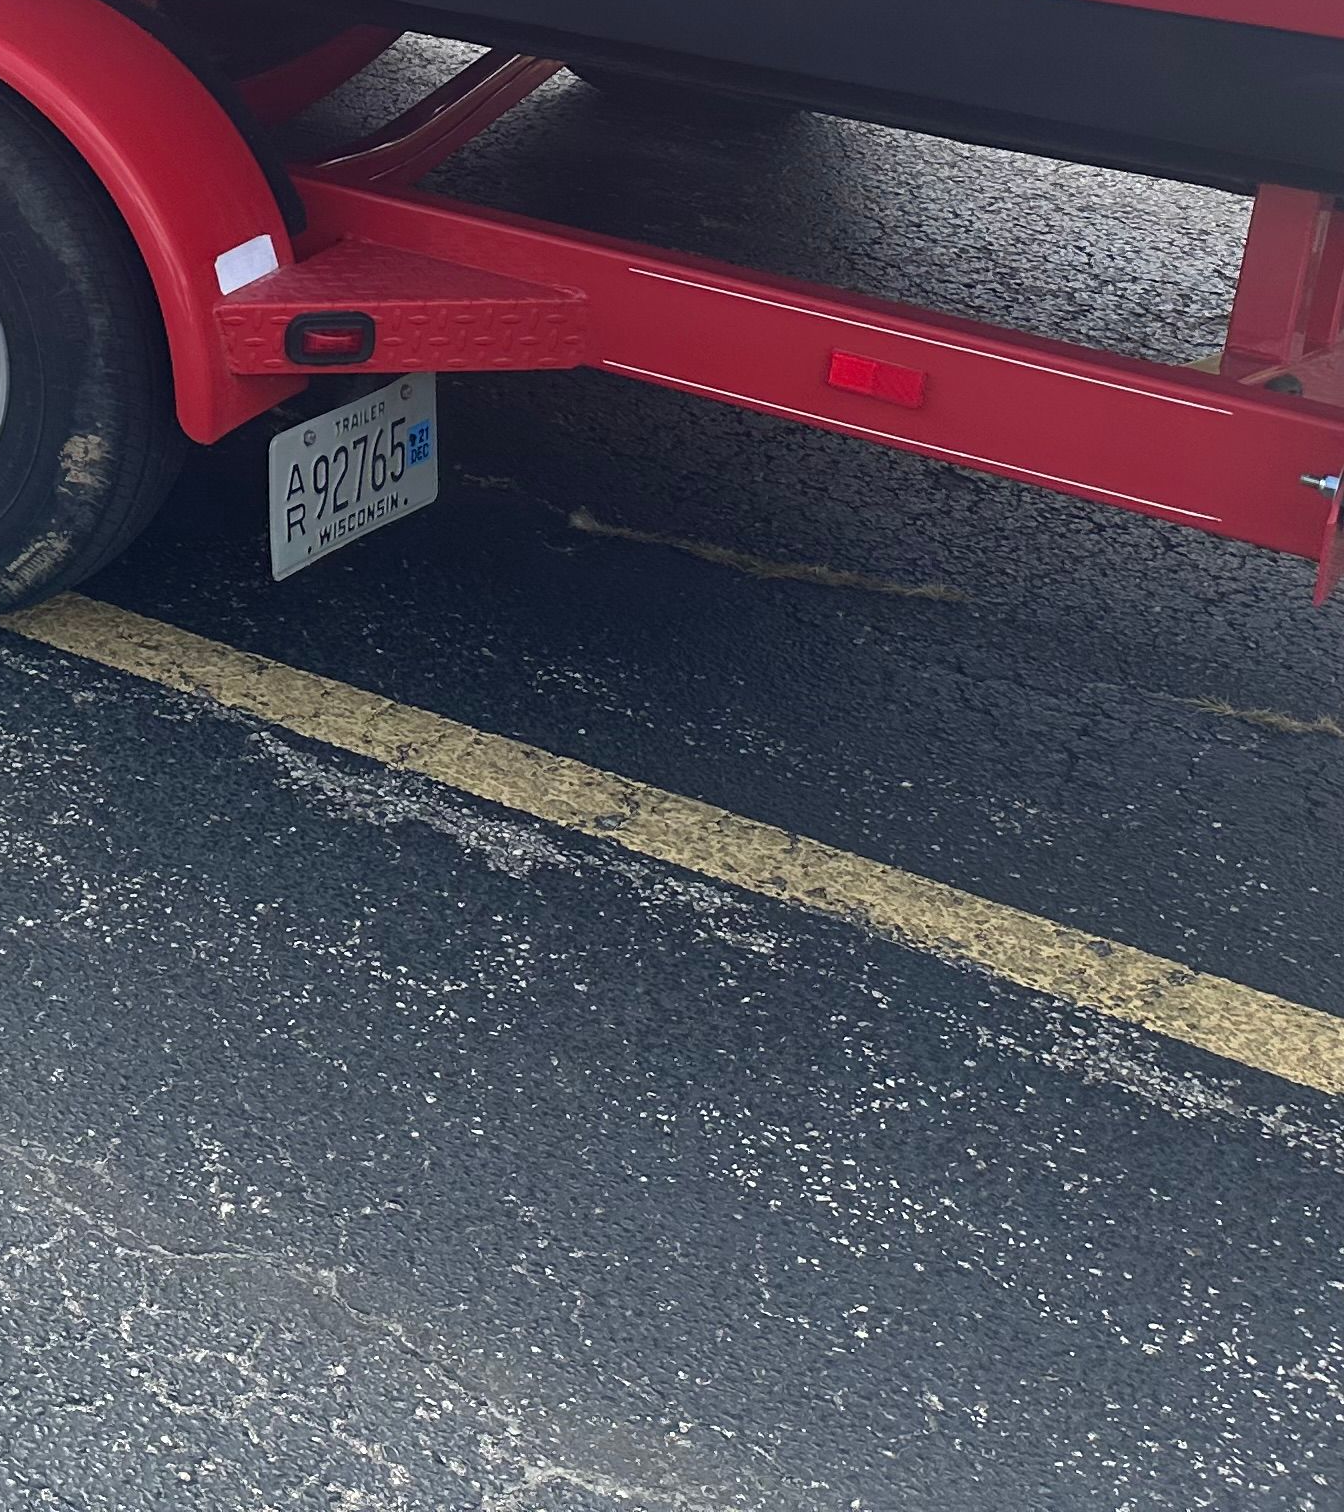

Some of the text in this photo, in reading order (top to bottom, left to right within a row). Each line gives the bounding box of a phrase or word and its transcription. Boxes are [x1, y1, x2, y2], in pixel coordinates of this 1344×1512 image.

[335, 401, 385, 436] TRAILER
[410, 443, 429, 464] DEC
[319, 492, 399, 546] WISCONSIN
